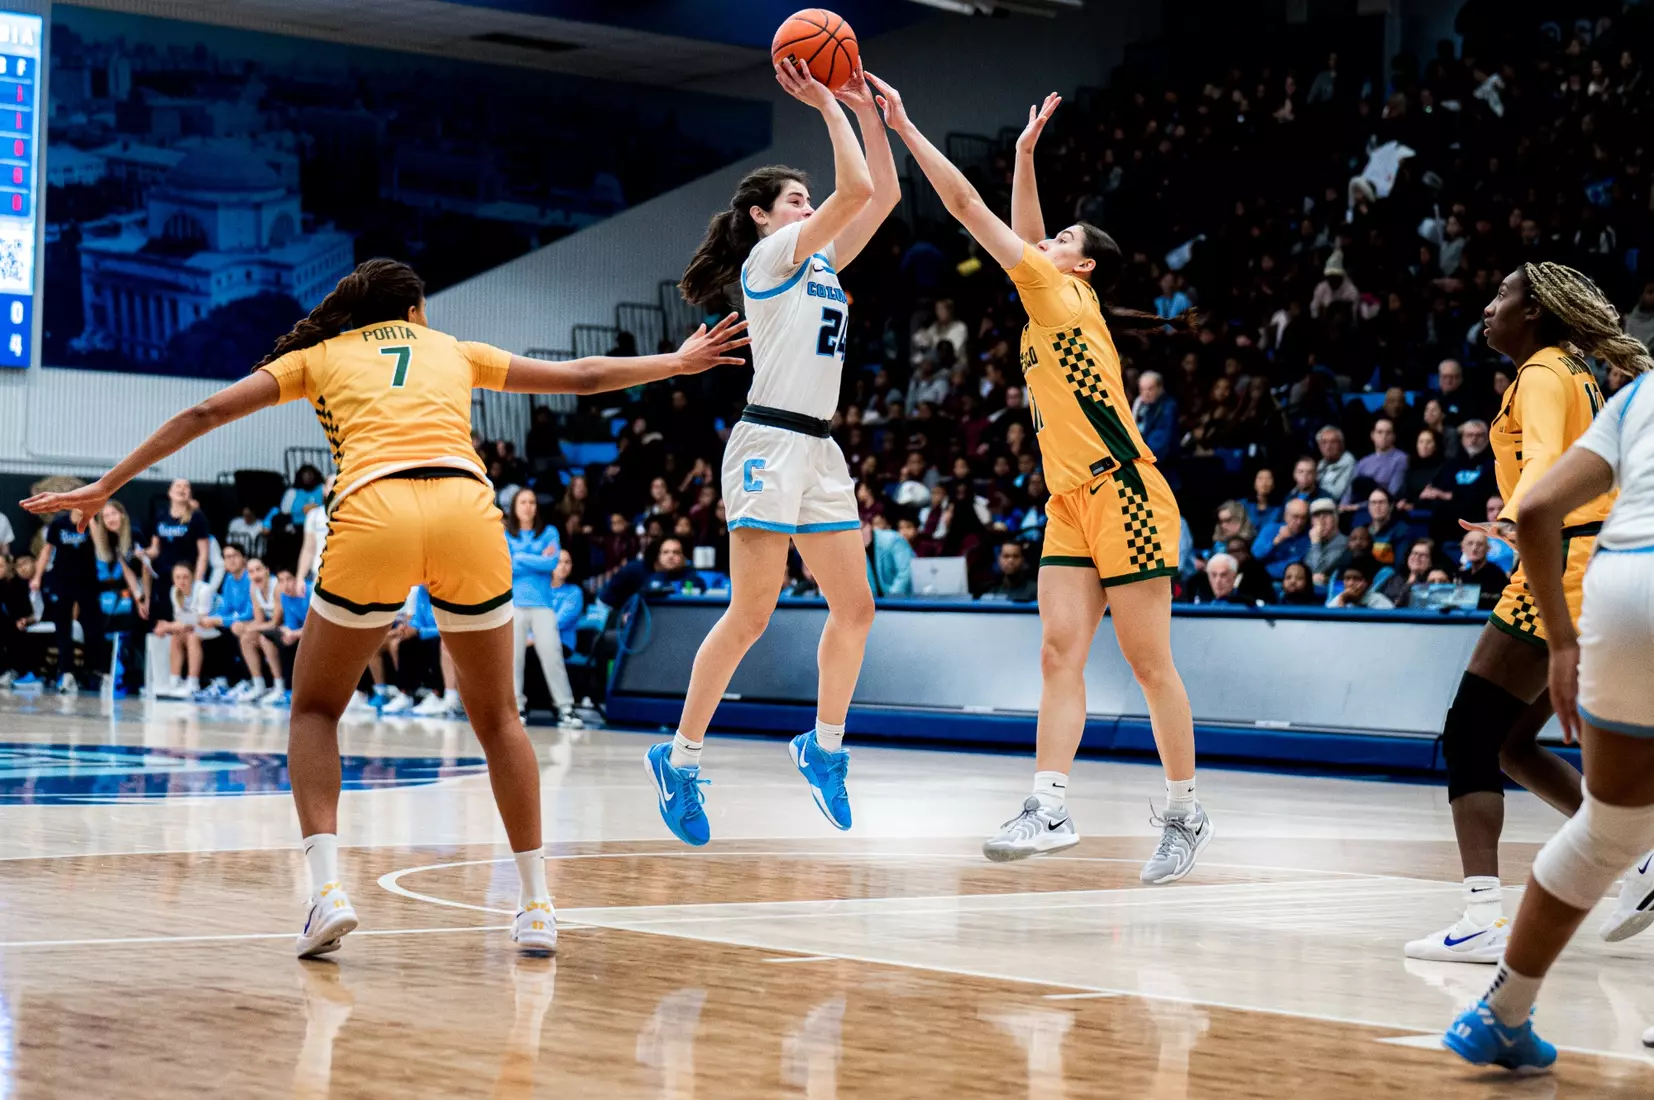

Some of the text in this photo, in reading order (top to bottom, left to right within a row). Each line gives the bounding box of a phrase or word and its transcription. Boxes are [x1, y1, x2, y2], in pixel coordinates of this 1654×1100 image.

[10, 300, 24, 325] 0
[362, 325, 417, 341] PORTA
[378, 345, 412, 388] 7
[743, 458, 766, 493] C
